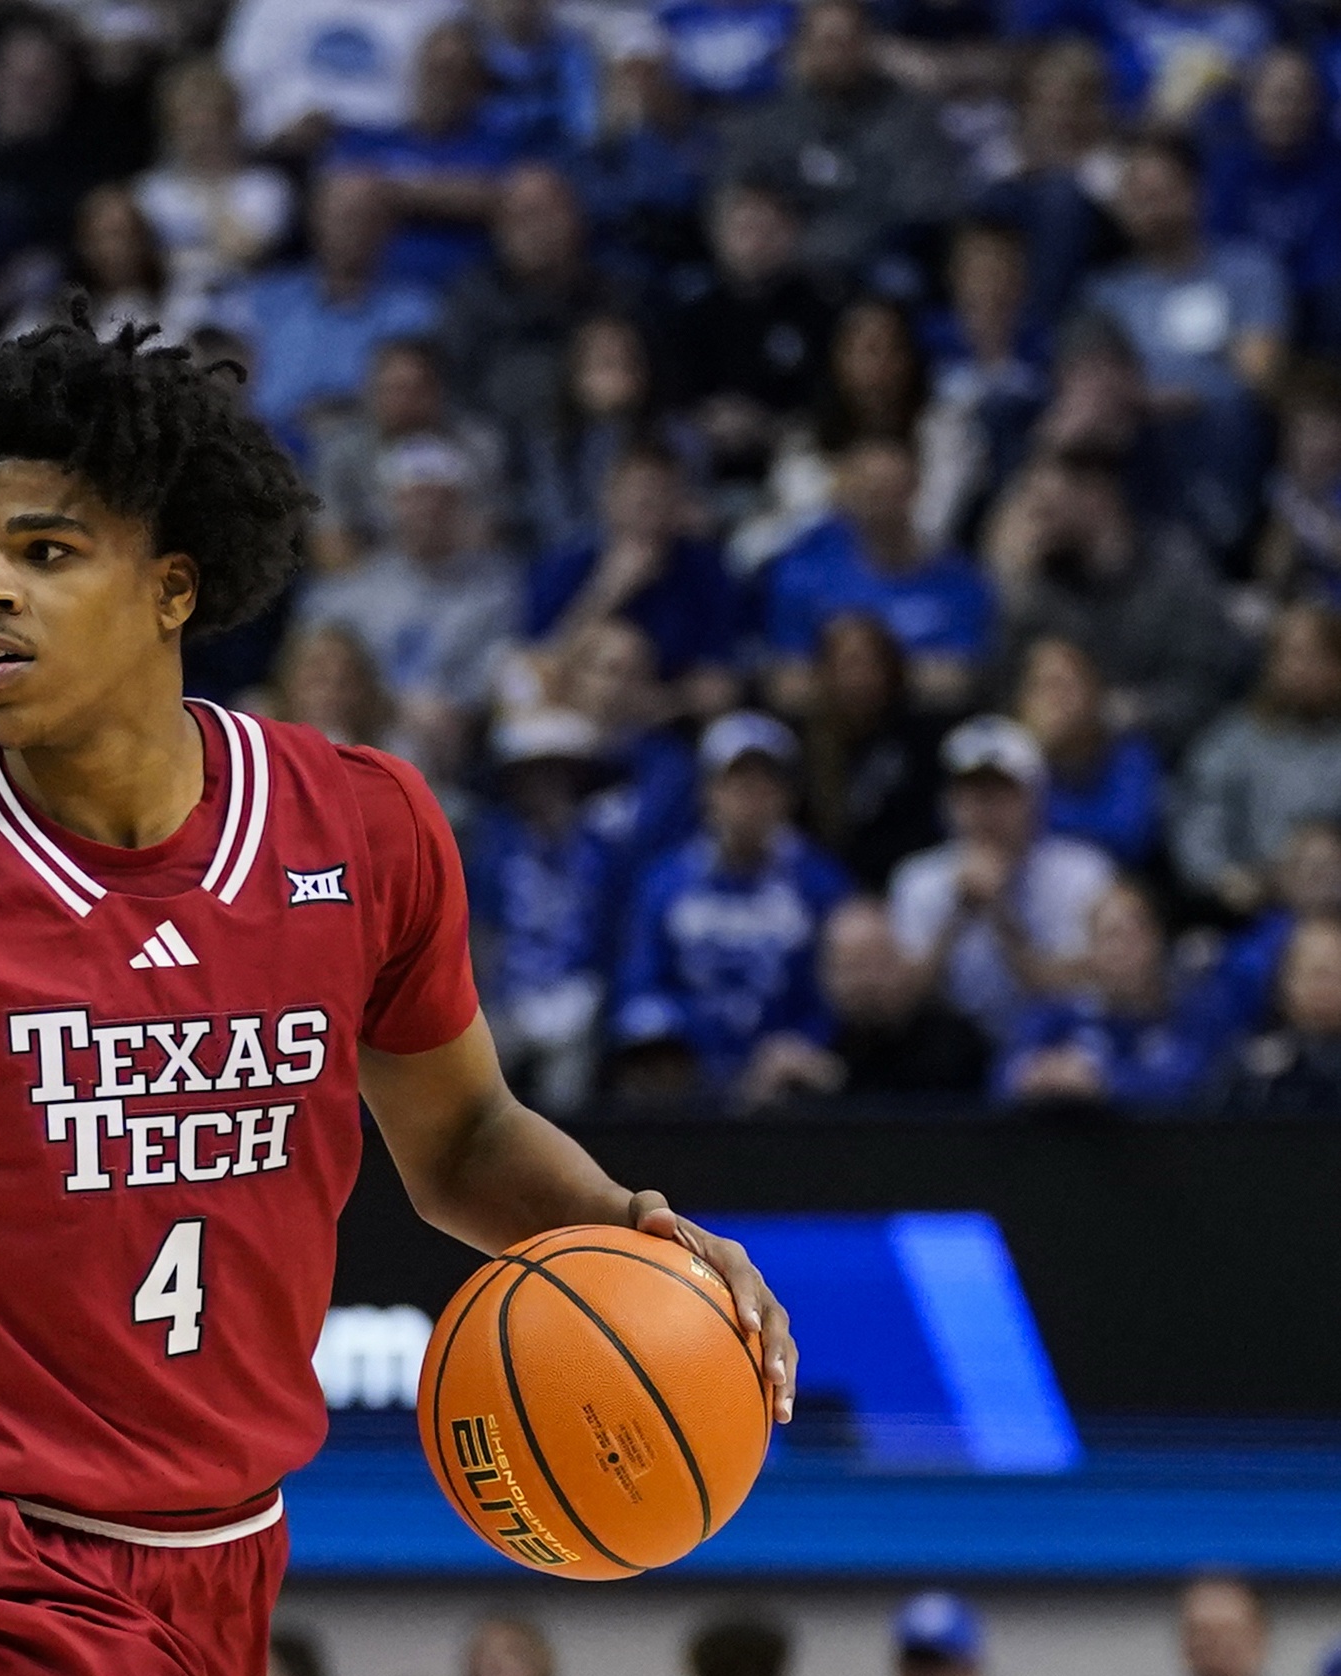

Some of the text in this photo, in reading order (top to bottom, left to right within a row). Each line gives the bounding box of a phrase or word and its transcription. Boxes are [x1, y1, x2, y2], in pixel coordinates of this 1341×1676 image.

[283, 862, 353, 907] XII
[9, 1009, 329, 1103] TEXAS
[45, 1098, 297, 1192] TECH
[132, 1217, 206, 1358] 4
[451, 1415, 570, 1567] ELITE
[488, 1414, 581, 1562] CHAMPIONSHIP
